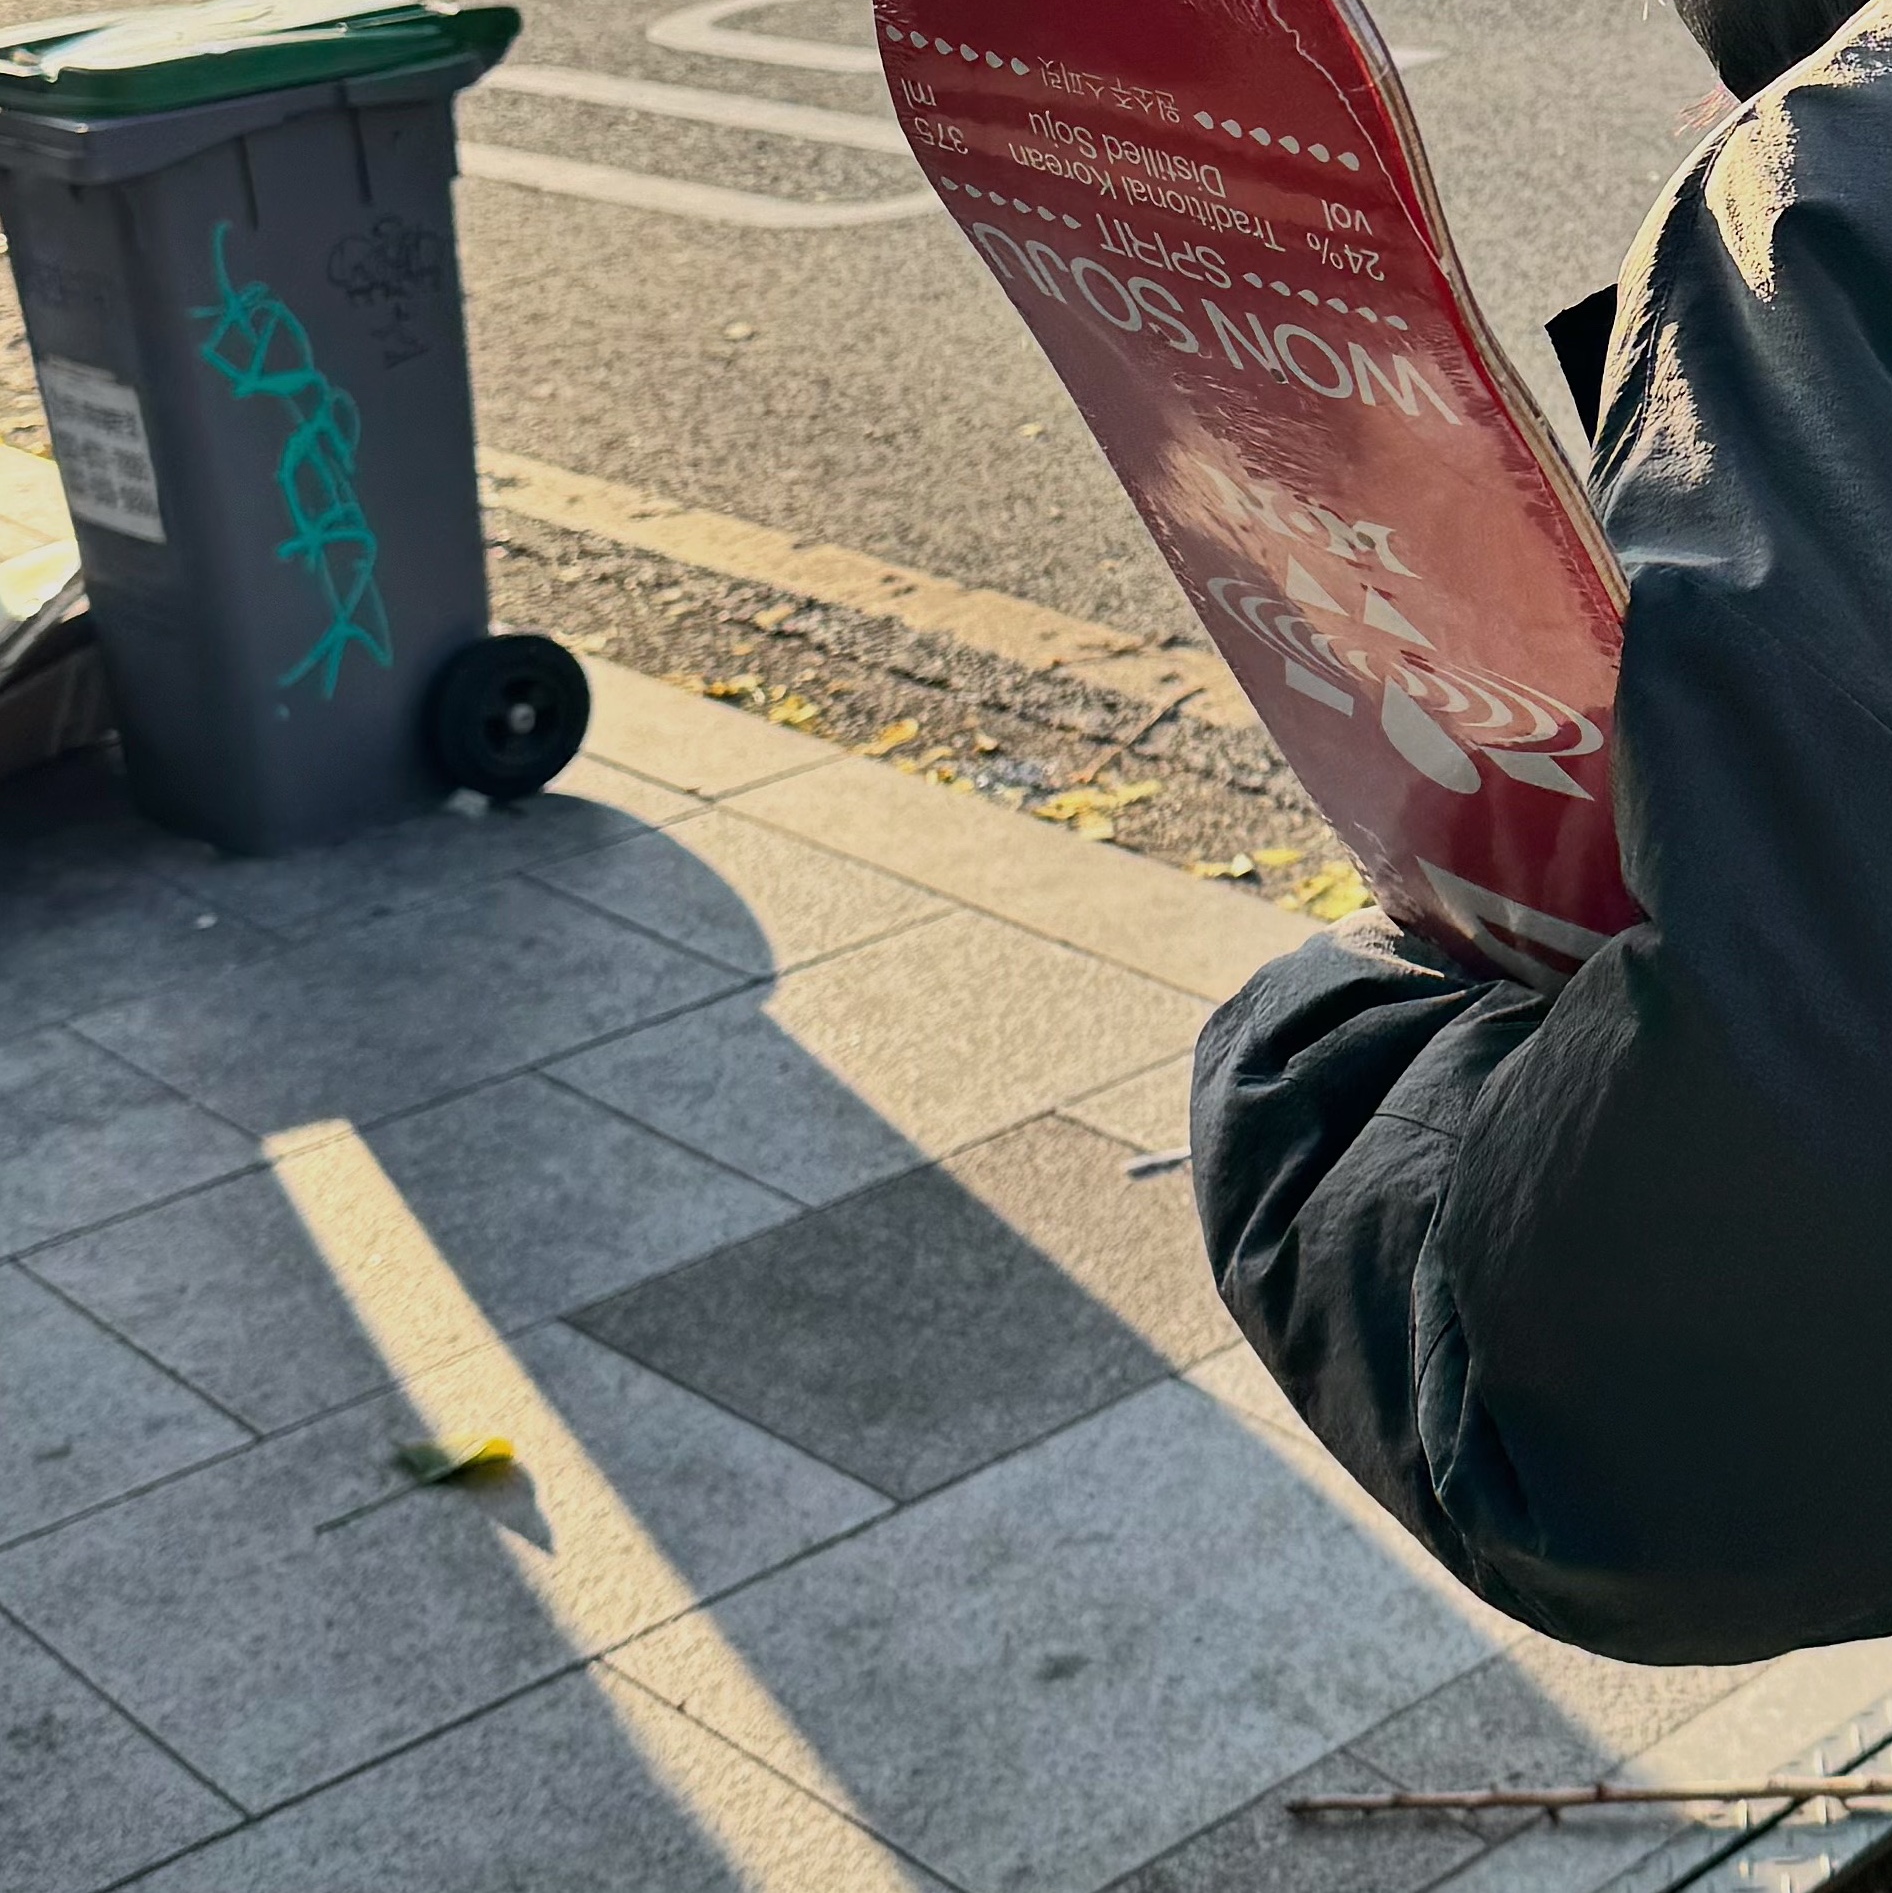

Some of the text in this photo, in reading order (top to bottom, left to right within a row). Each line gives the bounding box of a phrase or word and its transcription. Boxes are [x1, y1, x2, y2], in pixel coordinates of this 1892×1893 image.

[901, 78, 937, 110] ml
[914, 116, 969, 154] 375
[1029, 110, 1226, 198] Distilled Soju
[1008, 142, 1286, 252] Traditional Korean
[1321, 200, 1373, 236] vol
[1096, 213, 1232, 289] SPIRIT
[1306, 232, 1385, 281] 24%
[971, 222, 1463, 426] WON SOJU
